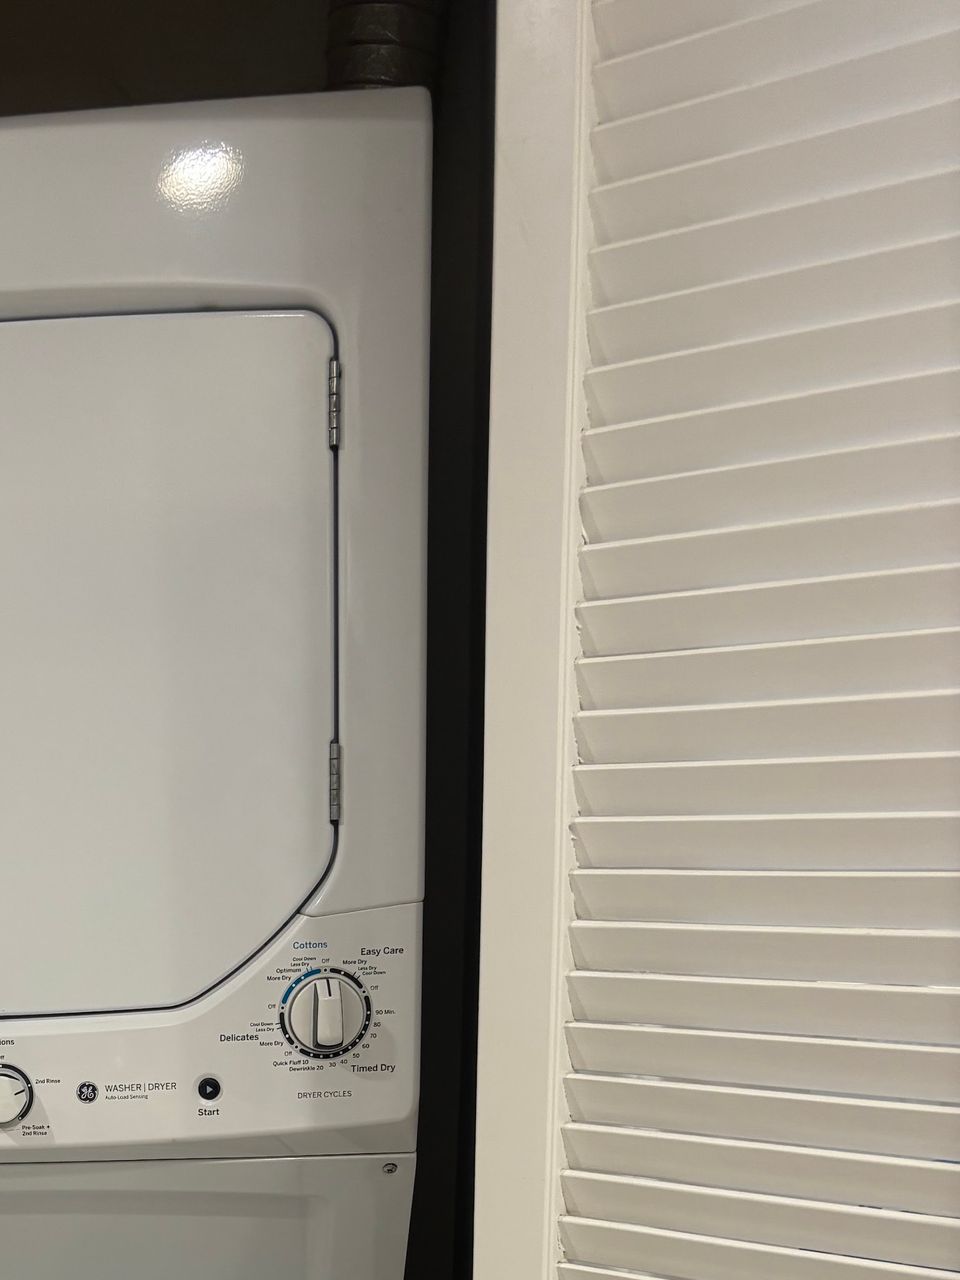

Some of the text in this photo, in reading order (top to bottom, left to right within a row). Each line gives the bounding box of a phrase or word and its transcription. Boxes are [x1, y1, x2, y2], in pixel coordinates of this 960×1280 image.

[360, 948, 381, 956] Easy
[220, 1034, 259, 1042] Delicates
[380, 1064, 396, 1072] Dry
[105, 1082, 177, 1092] WASHER DRYER
